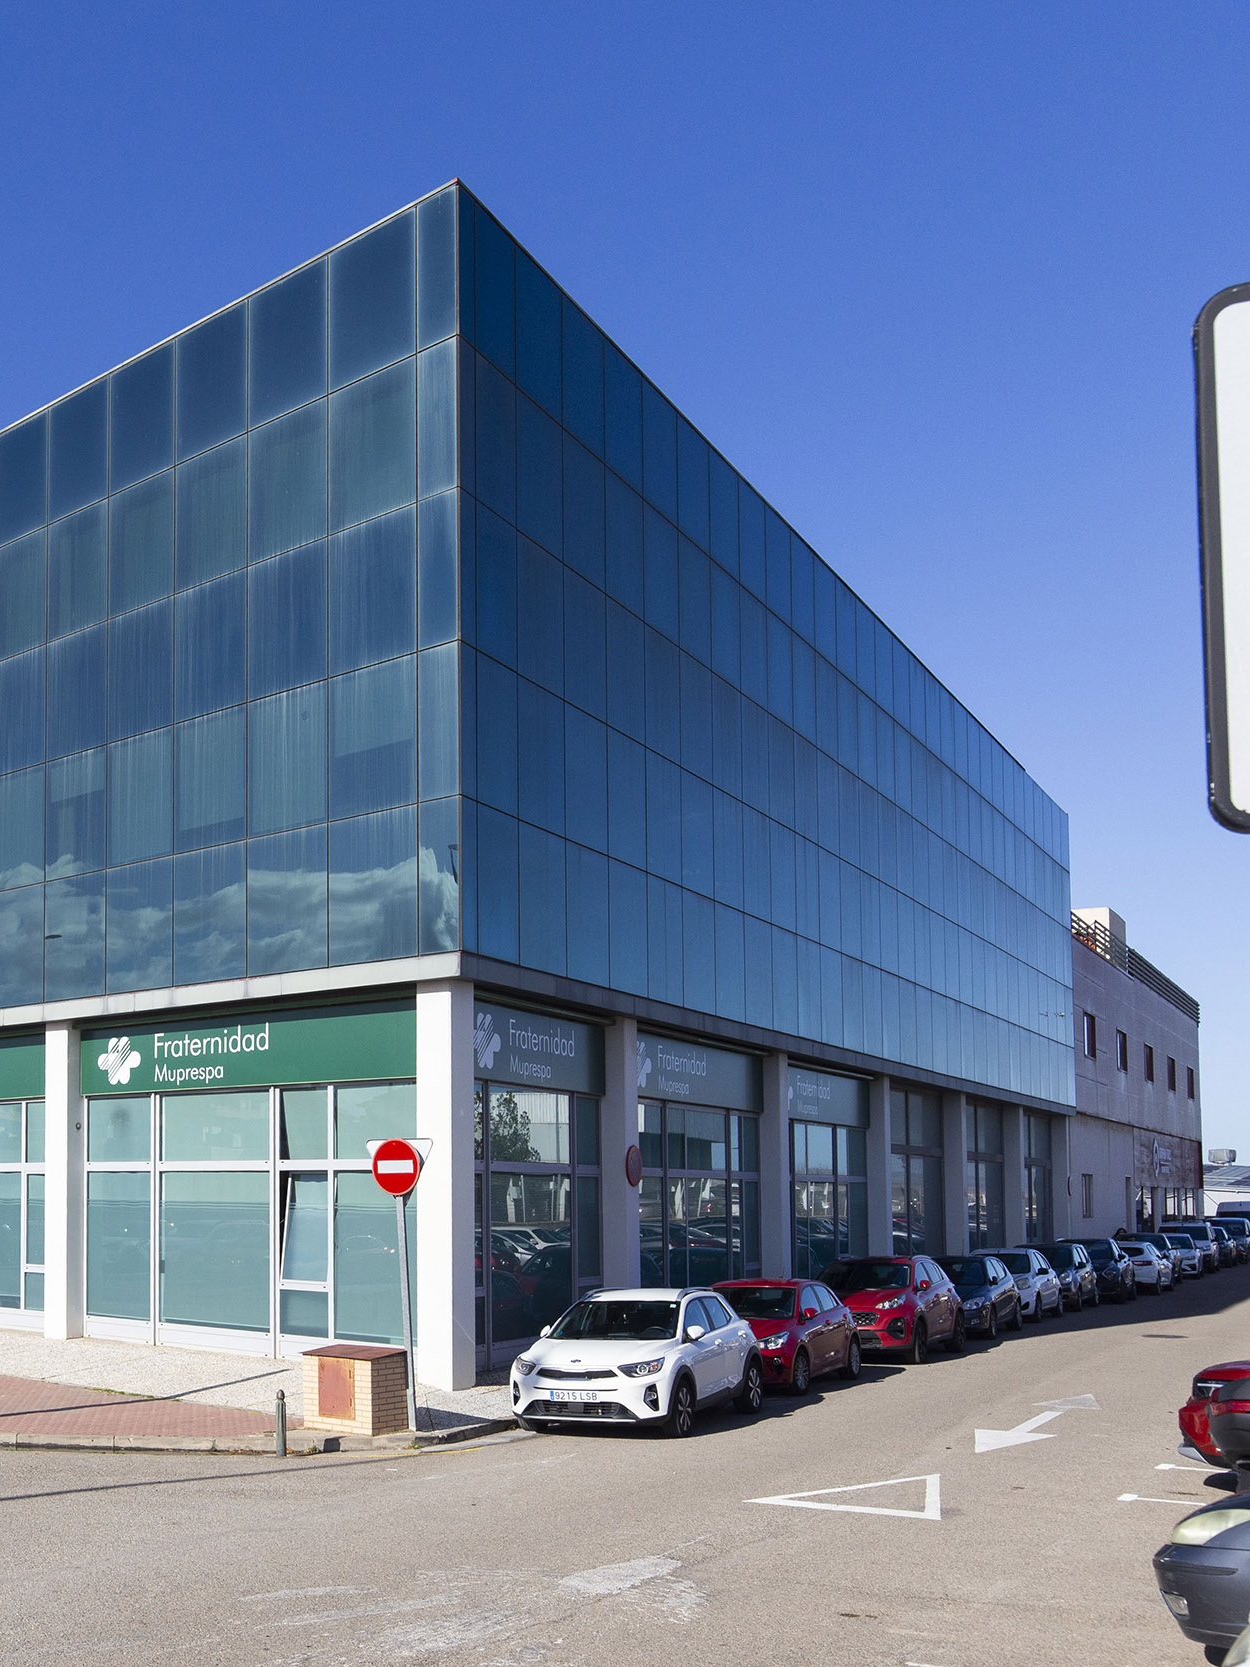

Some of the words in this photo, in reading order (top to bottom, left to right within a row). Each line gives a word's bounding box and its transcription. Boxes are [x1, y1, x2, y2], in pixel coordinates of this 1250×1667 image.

[154, 1022, 269, 1059] Fraternidad
[509, 1019, 575, 1058] Fraternidad
[509, 1054, 552, 1082] Muprespa
[657, 1045, 707, 1076] Fraternidad
[154, 1064, 224, 1086] Muprespa
[658, 1076, 690, 1095] Muprespa
[554, 1391, 578, 1401] 9215
[580, 1392, 598, 1401] LSB
